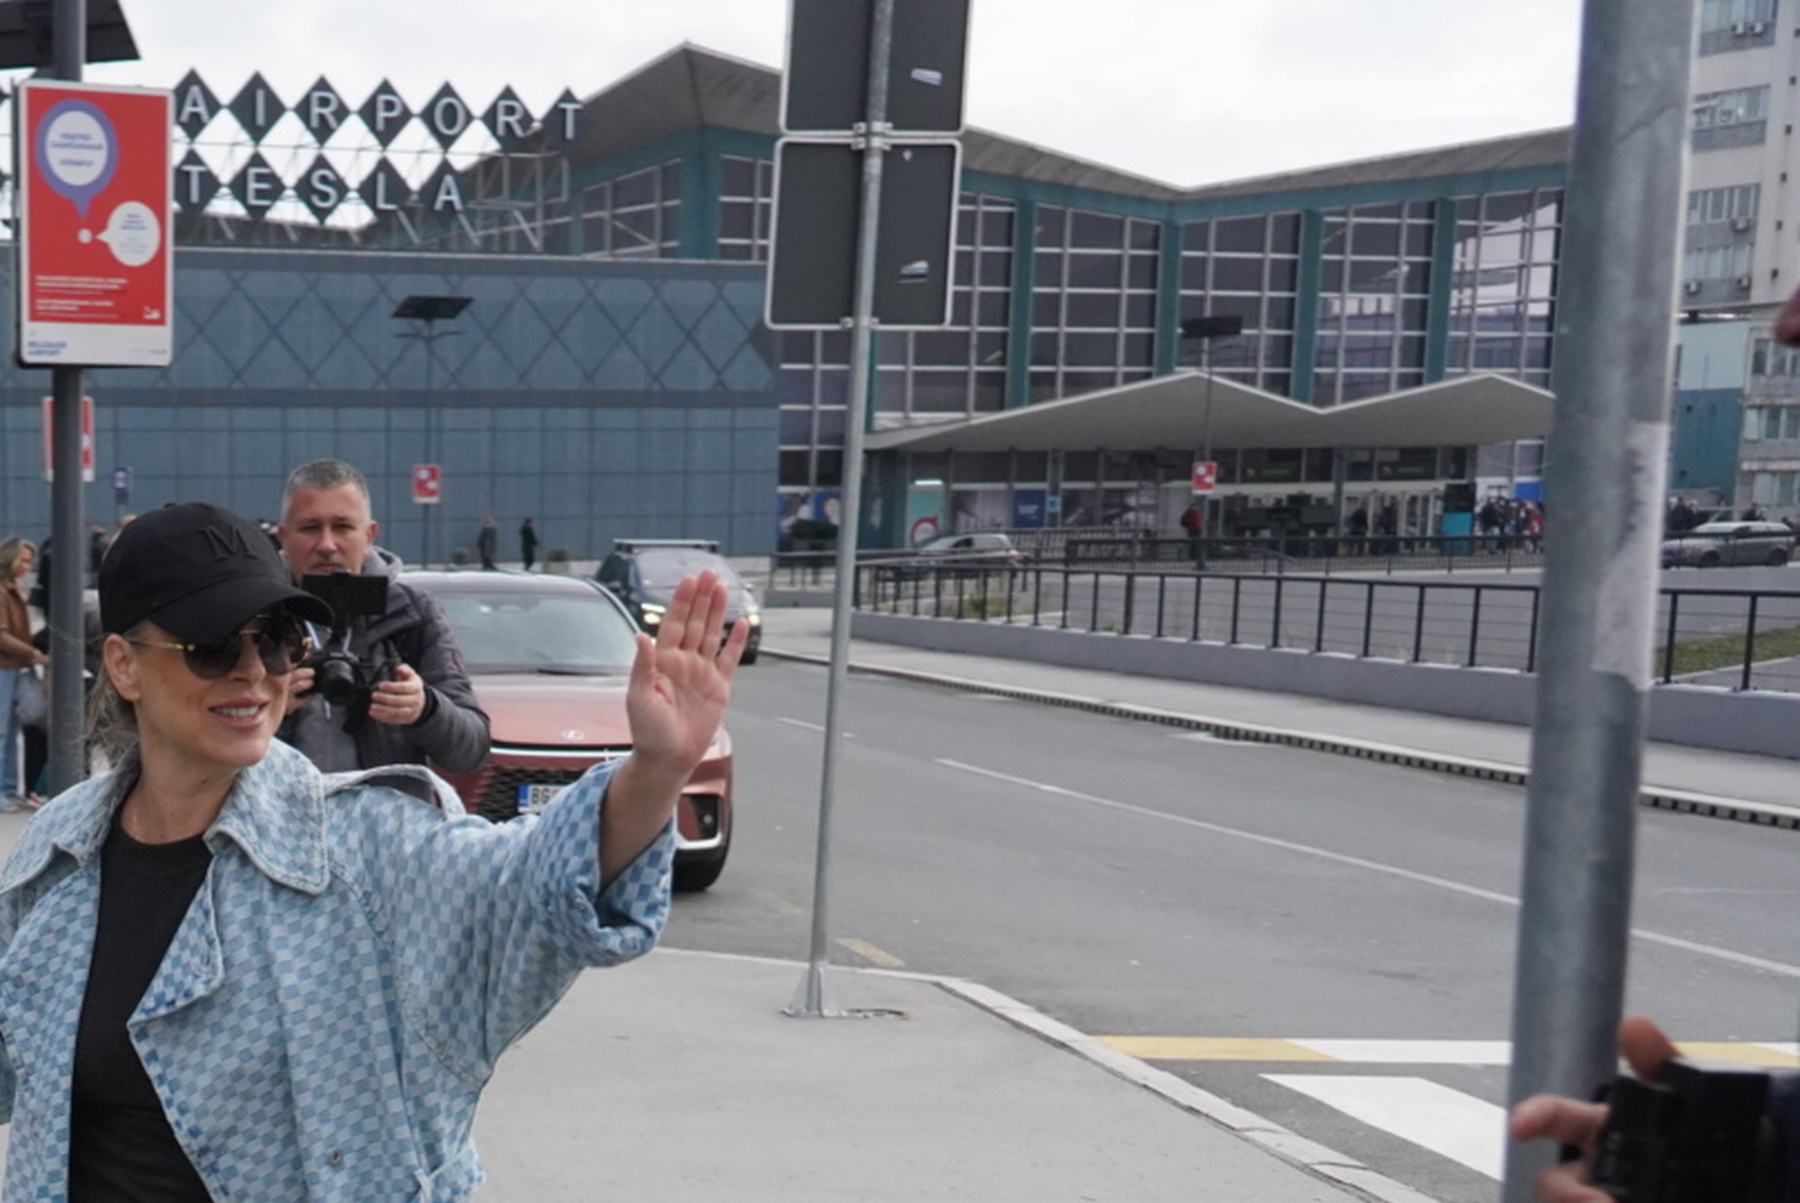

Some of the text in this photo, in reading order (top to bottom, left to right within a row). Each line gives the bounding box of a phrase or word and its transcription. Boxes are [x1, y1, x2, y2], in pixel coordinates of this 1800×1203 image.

[180, 83, 584, 141] AIRPORT
[181, 164, 464, 213] TESLA
[197, 523, 258, 563] M
[530, 786, 551, 805] BG
